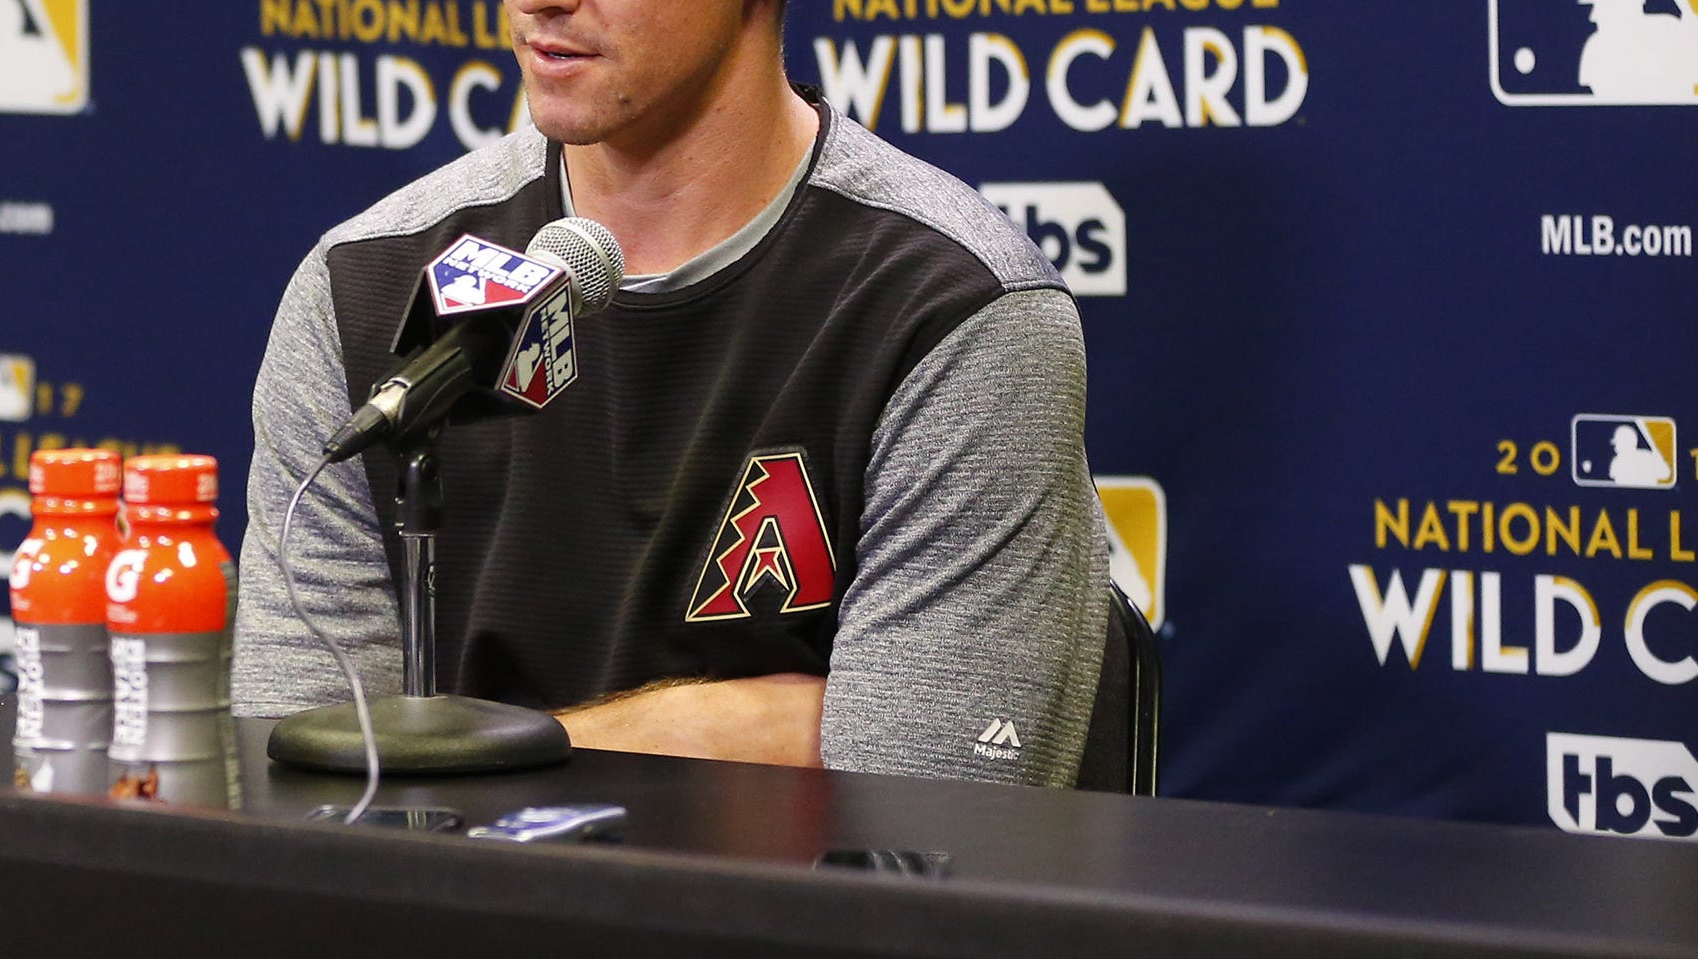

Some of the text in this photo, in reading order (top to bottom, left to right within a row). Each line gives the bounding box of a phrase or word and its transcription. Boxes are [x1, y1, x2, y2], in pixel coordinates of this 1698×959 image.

[240, 45, 438, 150] WILD
[813, 24, 1309, 134] WILD CARD
[451, 239, 552, 286] MLB
[1541, 214, 1693, 257] MLB.com
[443, 256, 534, 294] NETWORK
[539, 307, 555, 397] NETWORK
[546, 290, 575, 389] MLB
[1496, 440, 1561, 476] 20
[1375, 498, 1654, 561] NATIONAL
[106, 549, 150, 603] G
[1348, 563, 1603, 677] WILD
[973, 743, 1020, 760] Majestic
[1563, 753, 1698, 838] tbs
